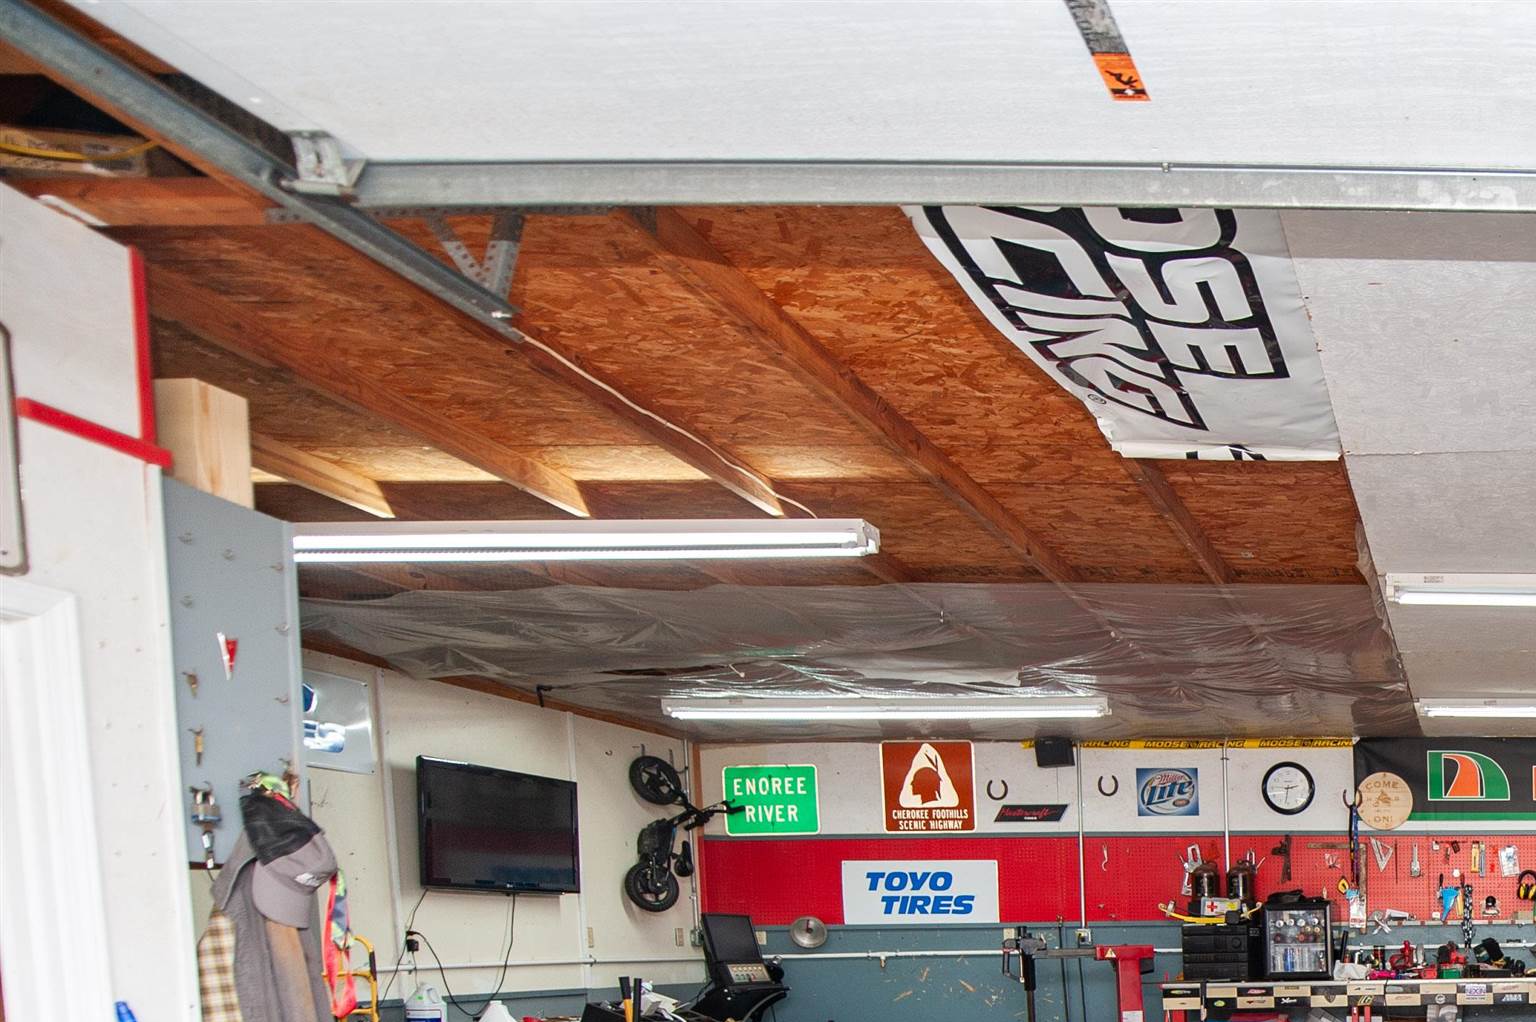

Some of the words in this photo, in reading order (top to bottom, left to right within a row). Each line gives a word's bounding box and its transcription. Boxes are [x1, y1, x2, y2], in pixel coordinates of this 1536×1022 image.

[1144, 740, 1186, 748] MOOSE
[1259, 740, 1300, 748] MOOSE
[1312, 740, 1353, 748] RACIN
[732, 778, 808, 795] ENOREE
[1365, 780, 1400, 789] COME
[745, 804, 799, 823] RIVER
[892, 810, 930, 819] CHEROKEE
[931, 810, 968, 819] FOOTHILLS
[898, 820, 925, 830] SCENIC
[926, 820, 963, 830] HIGHWAY
[866, 871, 953, 891] TOYO
[881, 895, 975, 915] TIRES
